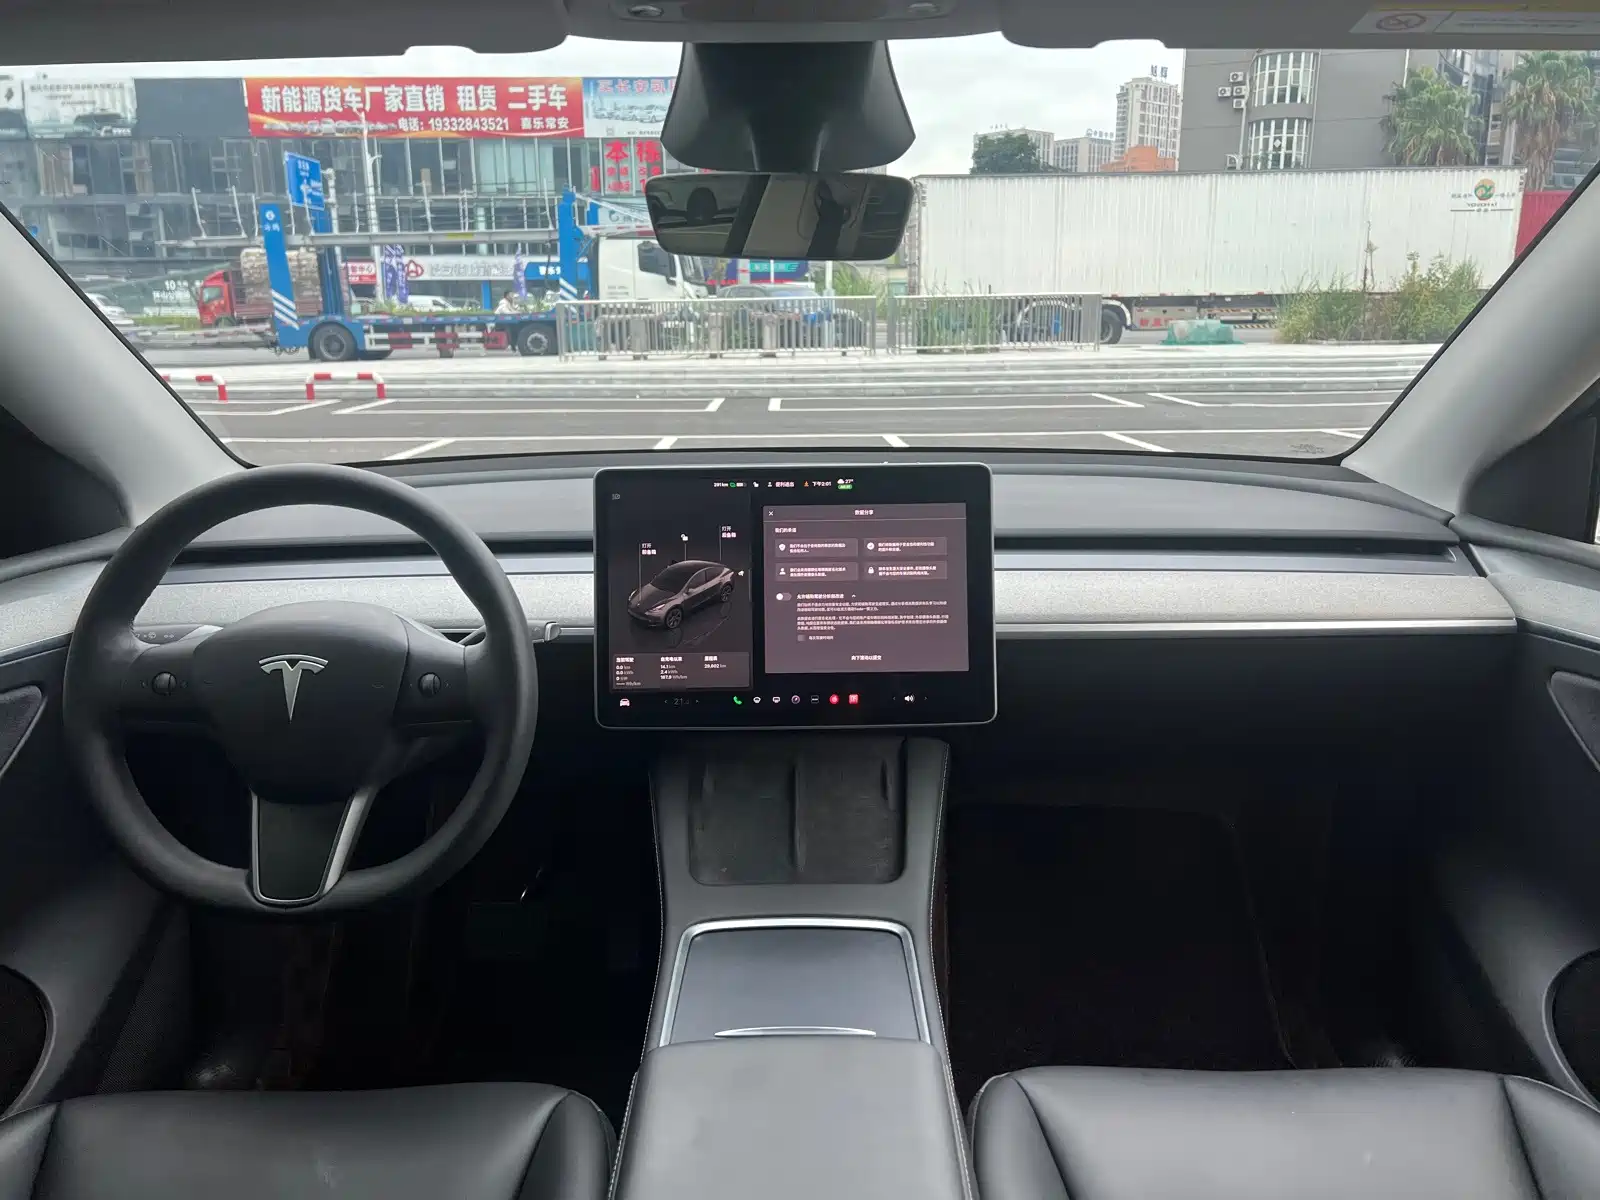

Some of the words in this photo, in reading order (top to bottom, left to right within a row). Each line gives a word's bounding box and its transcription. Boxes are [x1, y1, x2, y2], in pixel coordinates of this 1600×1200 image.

[261, 85, 445, 113] 新能源货车厂家直销
[457, 84, 497, 111] 租赁
[508, 84, 567, 111] 二手车
